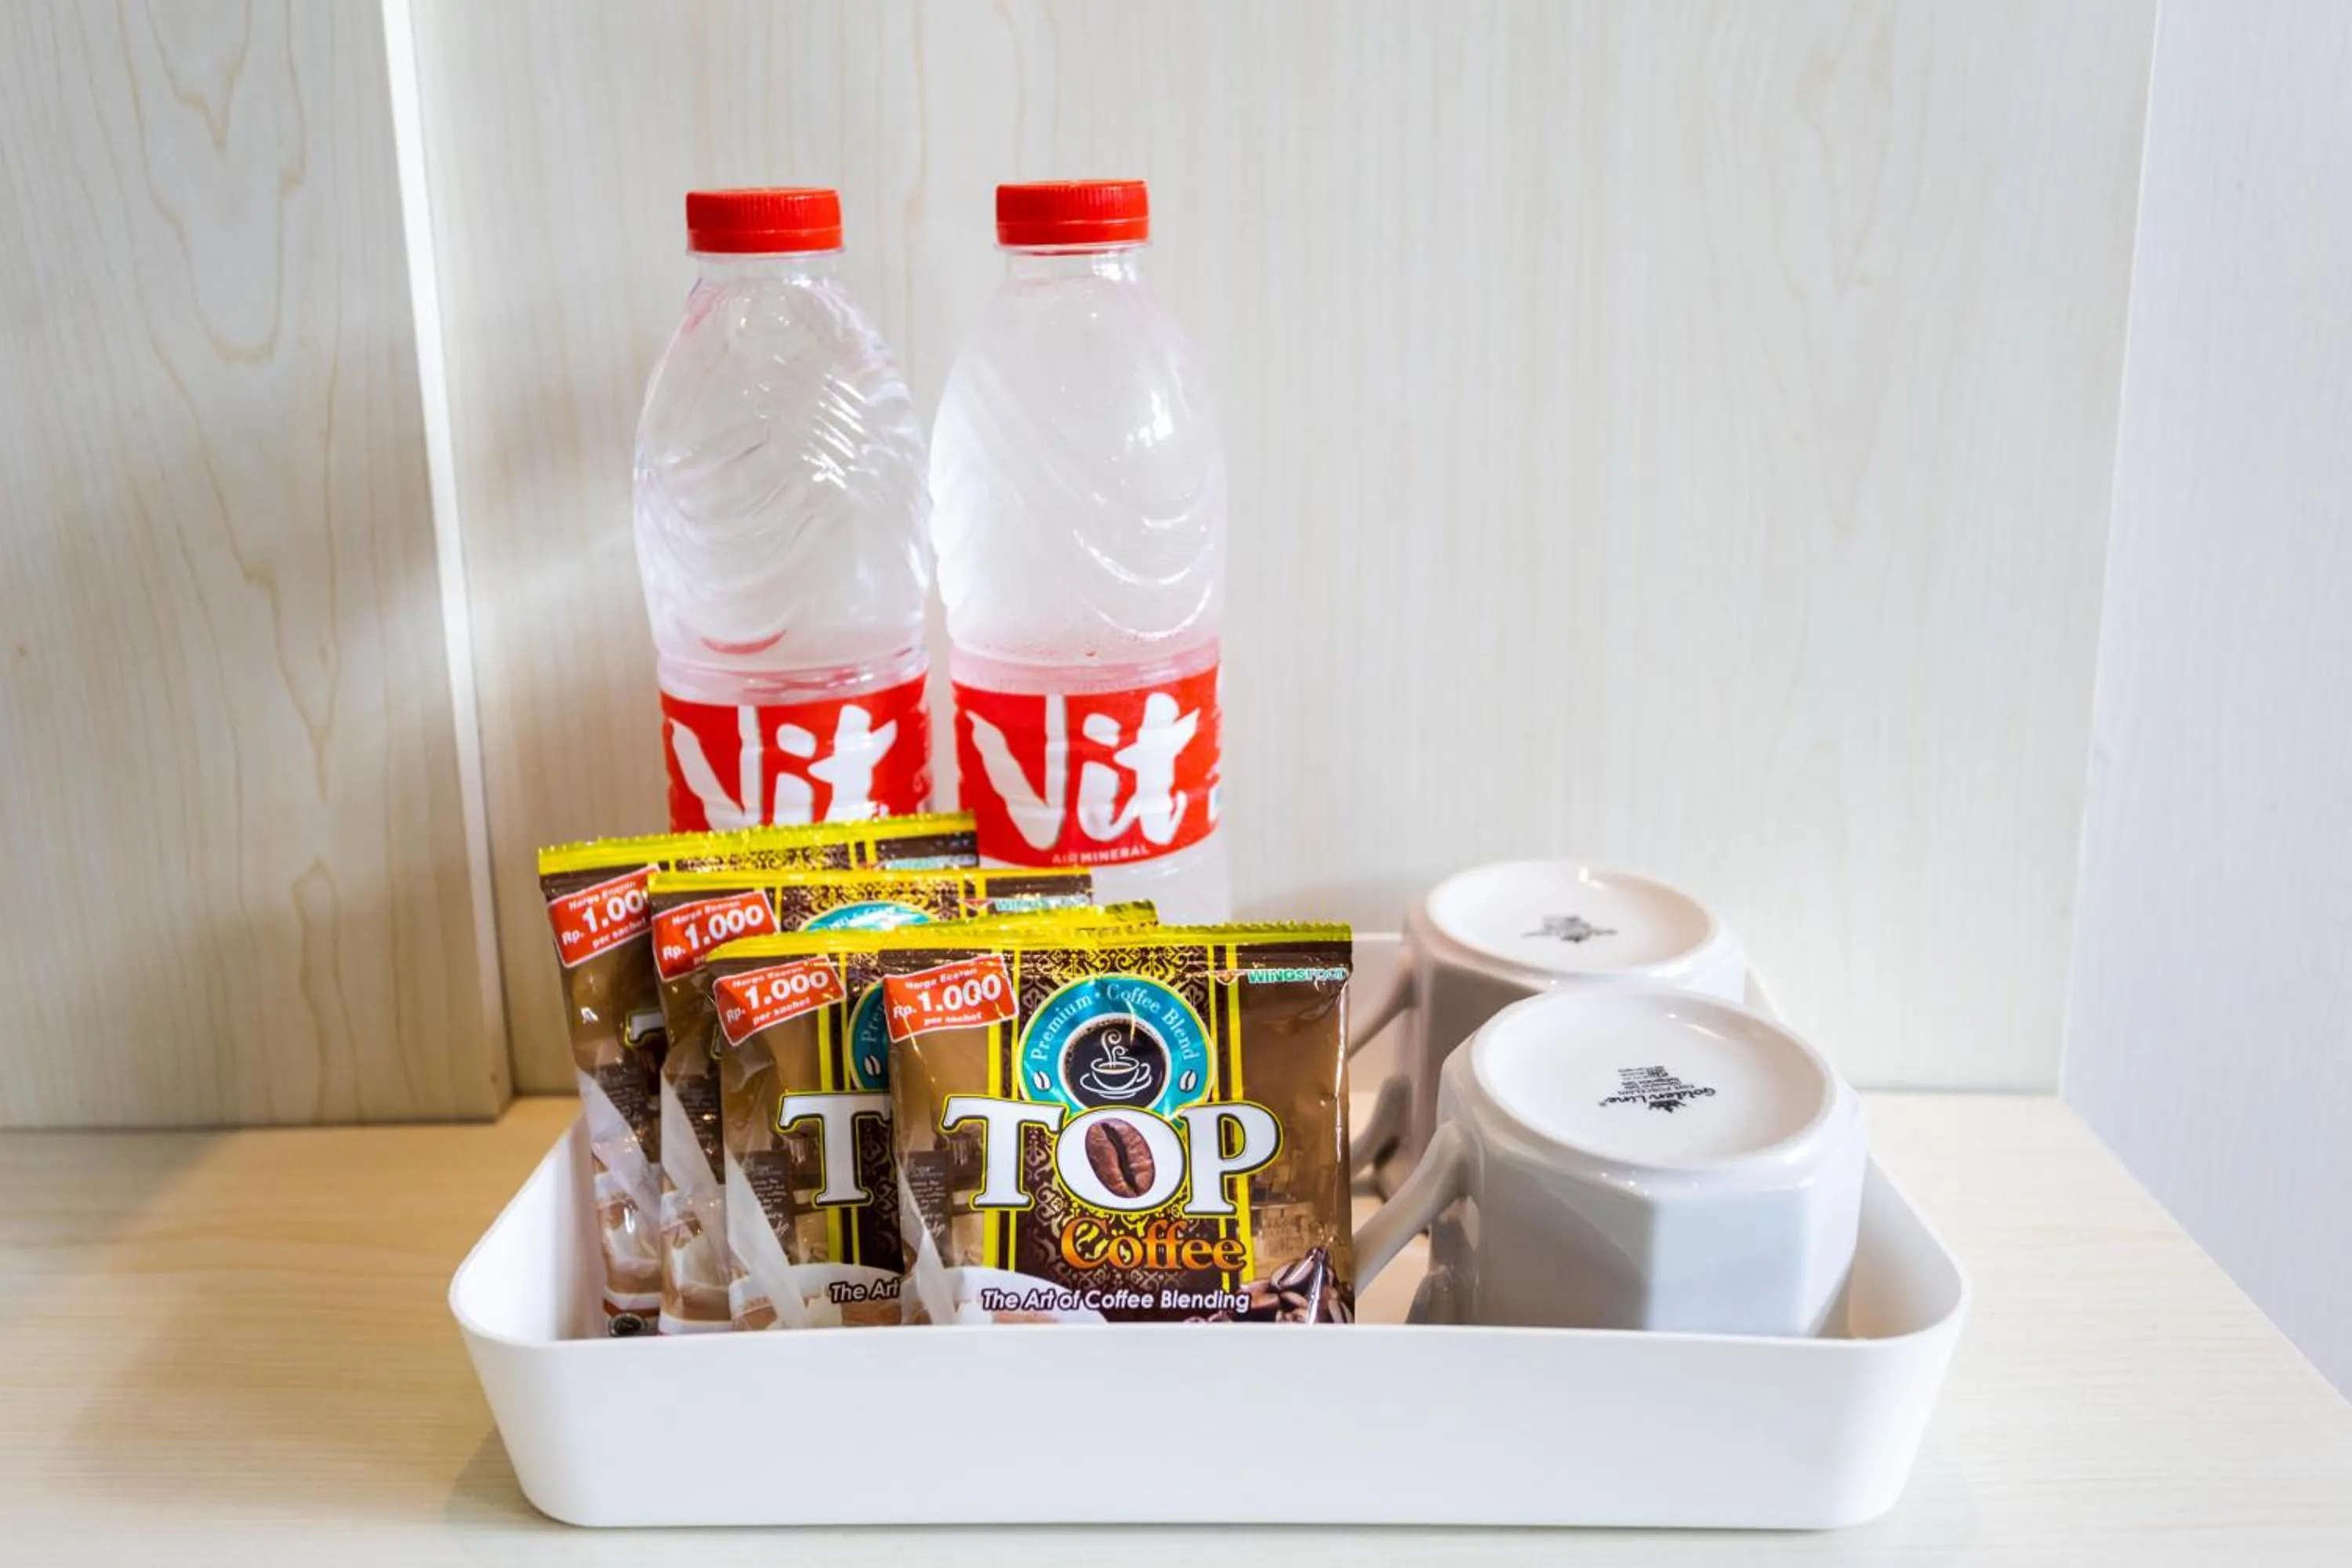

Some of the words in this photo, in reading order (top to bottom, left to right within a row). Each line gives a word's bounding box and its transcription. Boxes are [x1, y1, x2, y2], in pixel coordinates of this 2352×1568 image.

[670, 704, 898, 828] Vit
[966, 692, 1200, 851] Vit
[1051, 854, 1077, 864] AIR
[1081, 844, 1149, 862] MINERAL
[561, 931, 585, 946] Rp.
[662, 945, 687, 960] Rp.
[684, 904, 764, 951] 1.000
[726, 1007, 746, 1023] Rp.
[746, 971, 829, 1010] 1.000
[753, 1012, 771, 1026] per
[773, 996, 811, 1016] sachet
[893, 1005, 916, 1019] Rp.
[917, 973, 1002, 1012] 1.000
[924, 1017, 943, 1027] per
[945, 1011, 982, 1024] sachet
[1031, 993, 1094, 1061] Premium
[1106, 984, 1162, 1014] Coffee
[1162, 1007, 1201, 1060] Blend
[943, 1096, 1281, 1215] TOP
[1061, 1218, 1247, 1271] Coffee
[831, 1283, 866, 1302] The
[870, 1279, 899, 1299] Art
[983, 1289, 1019, 1309] The
[1022, 1289, 1057, 1309] Art
[1058, 1289, 1084, 1309] of
[1085, 1290, 1155, 1309] Coffee
[1160, 1290, 1250, 1312] Blending
